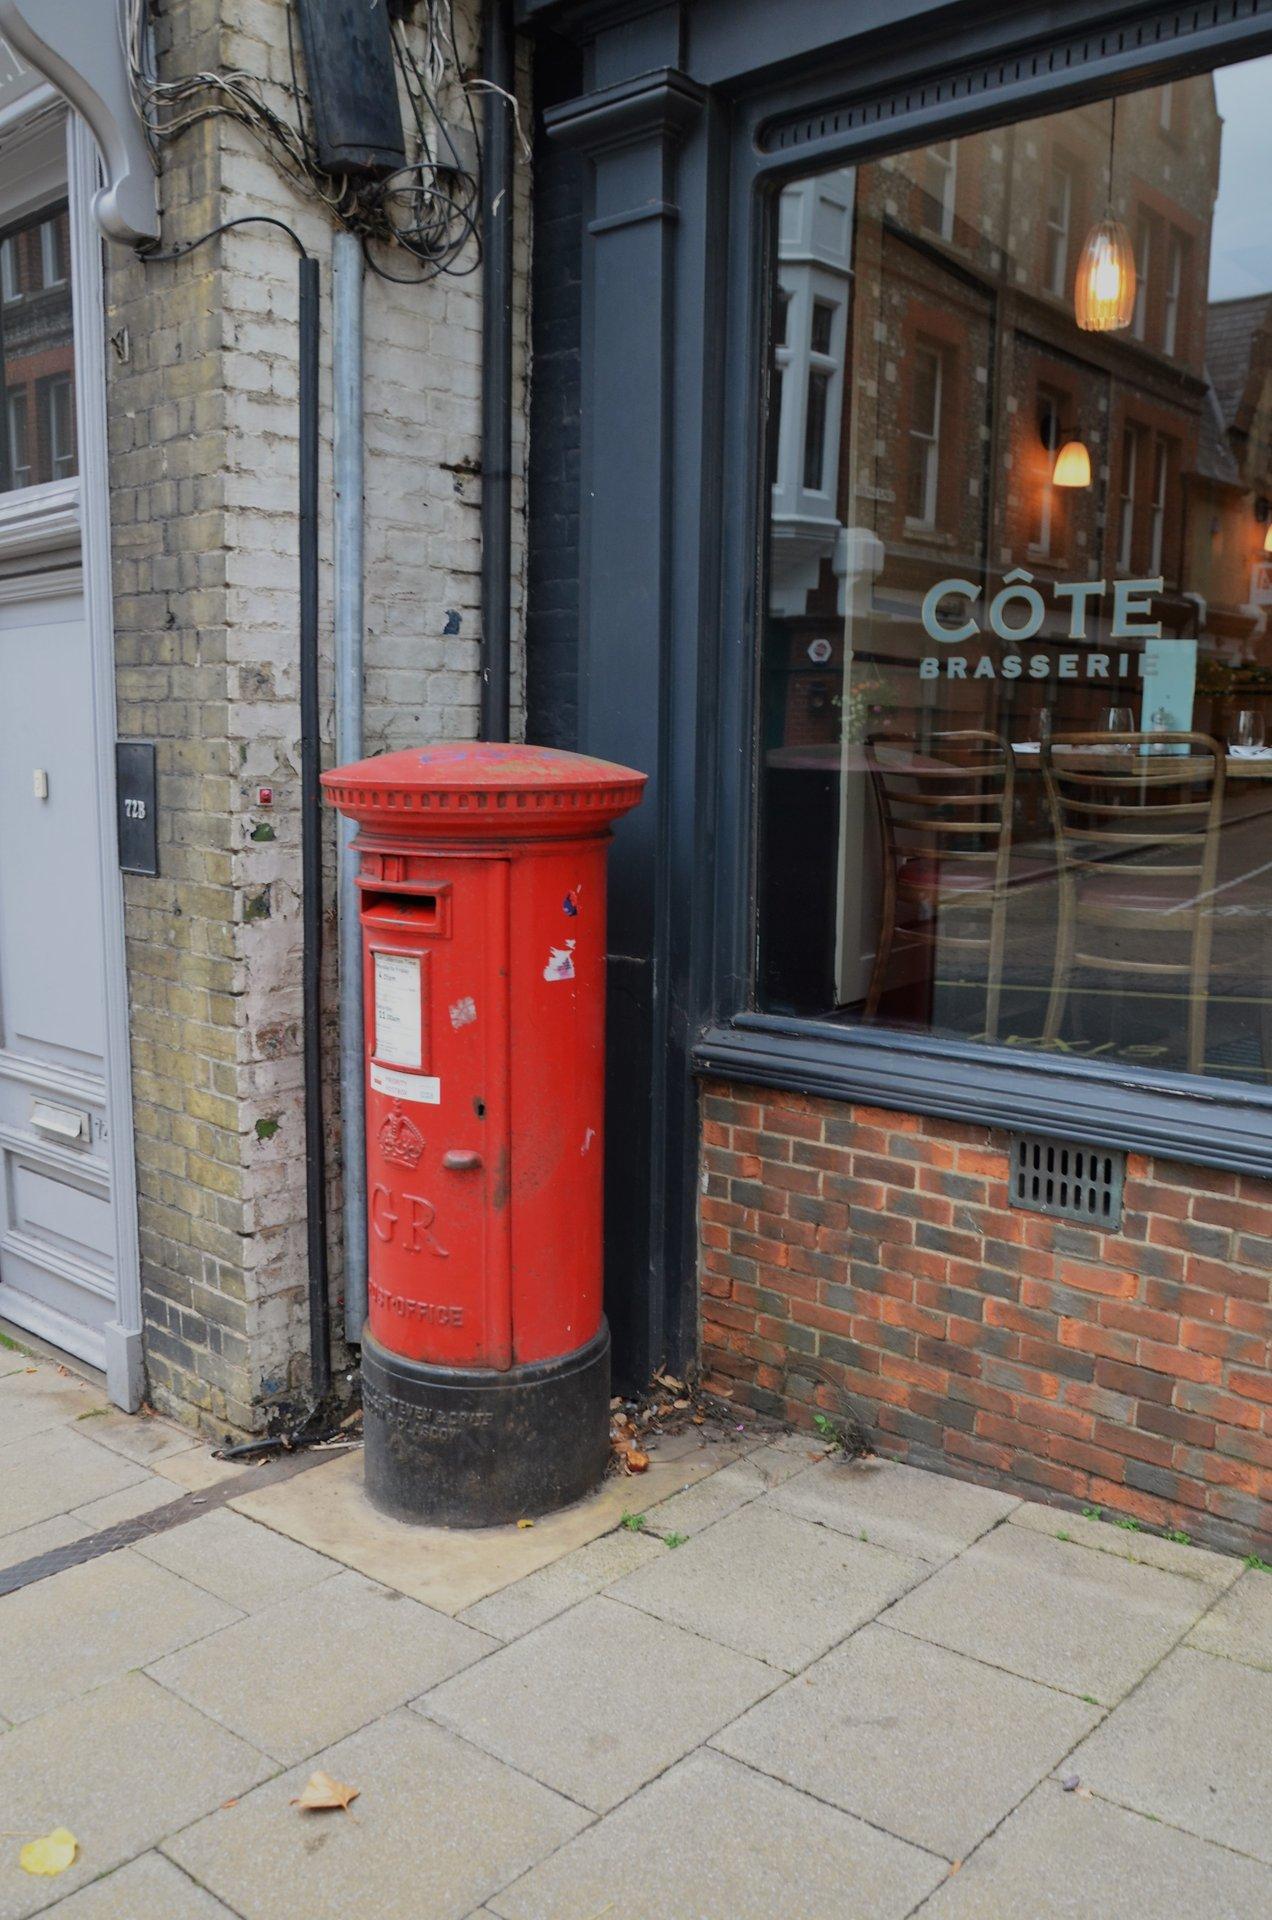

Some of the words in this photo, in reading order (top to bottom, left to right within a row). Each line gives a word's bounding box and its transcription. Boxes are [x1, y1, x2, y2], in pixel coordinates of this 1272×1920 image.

[921, 567, 1165, 643] CÔTE
[919, 652, 1160, 680] BRASSERIE
[124, 798, 146, 819] 72B
[371, 1183, 450, 1258] GR
